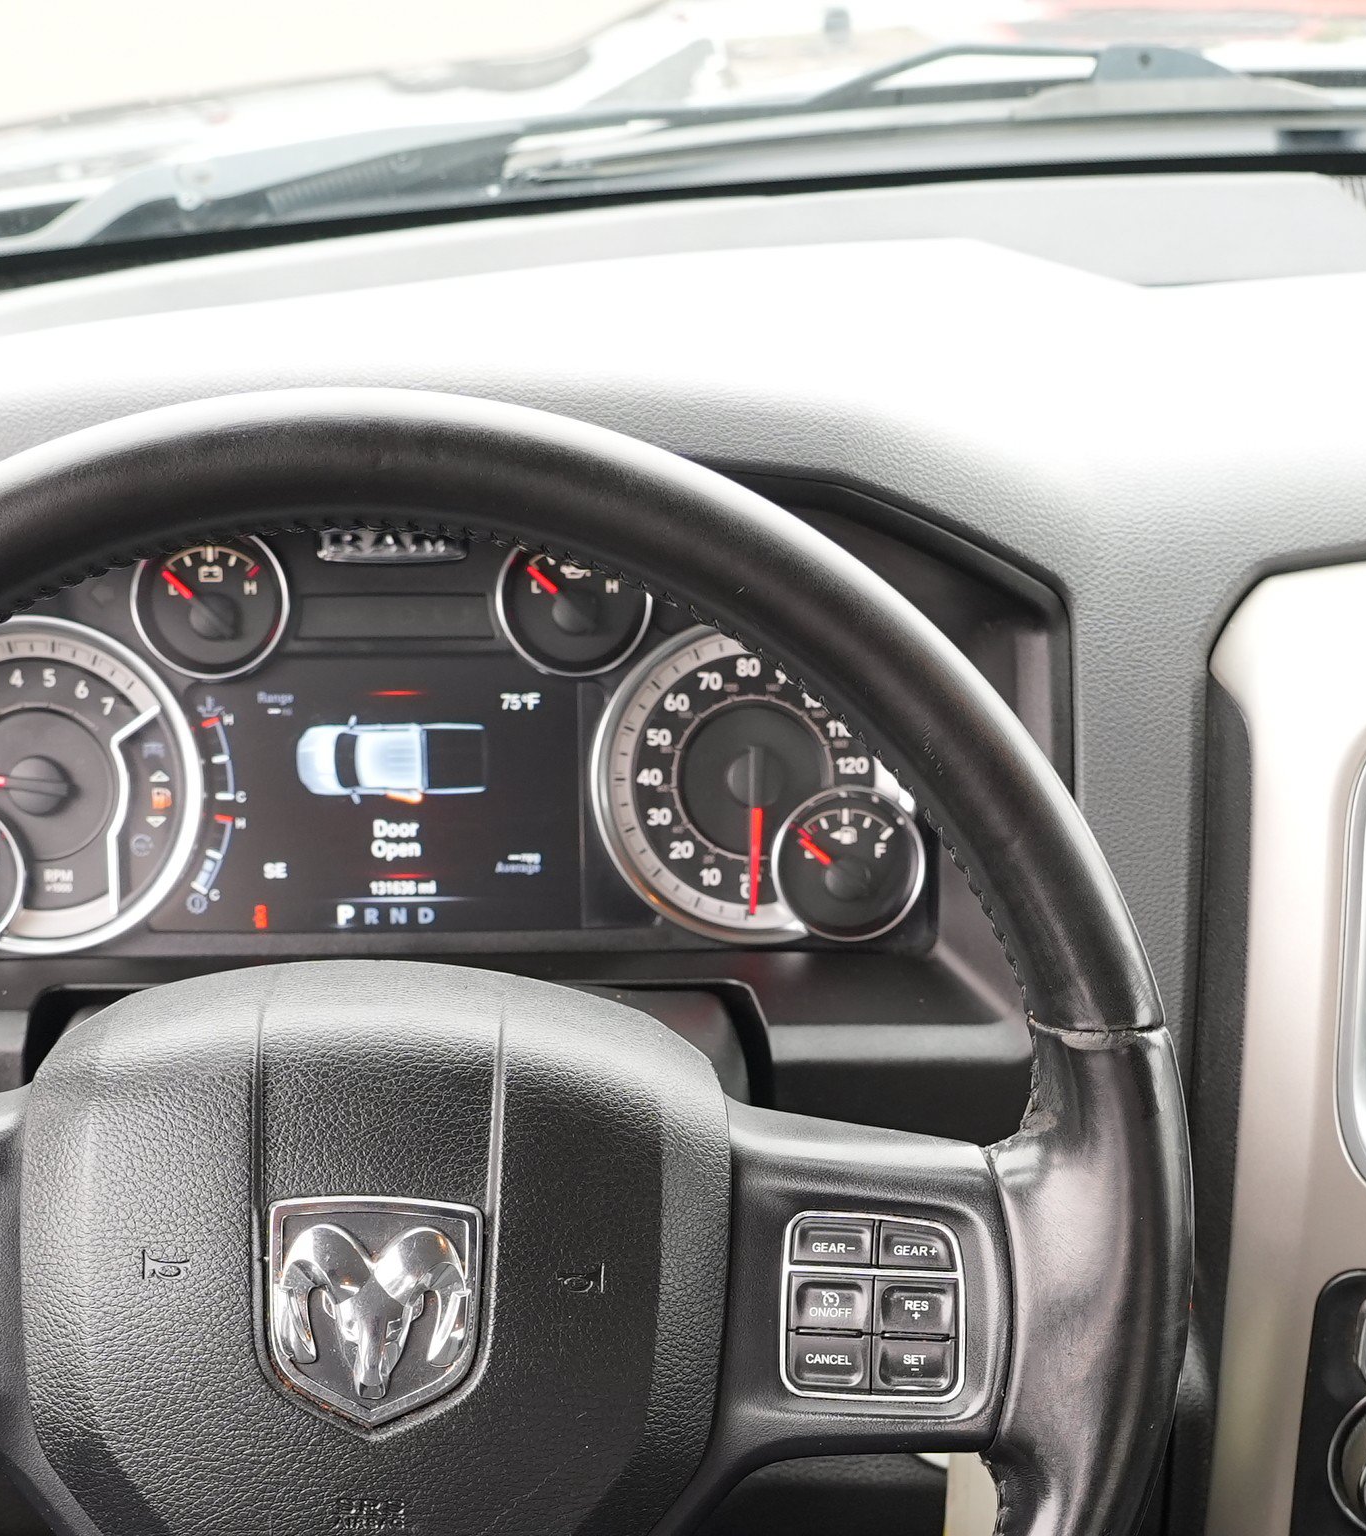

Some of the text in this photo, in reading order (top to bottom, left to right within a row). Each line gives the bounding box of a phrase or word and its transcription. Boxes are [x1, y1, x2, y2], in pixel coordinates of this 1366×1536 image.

[736, 658, 761, 677] 80
[9, 668, 24, 688] 4
[43, 668, 57, 688] 5
[696, 671, 723, 691] 70
[75, 680, 89, 699] 6
[100, 697, 116, 716] 7
[663, 693, 690, 712] 60
[646, 728, 672, 747] 50
[836, 756, 869, 774] 120
[637, 768, 663, 786] 40
[646, 807, 672, 826] 30
[373, 819, 419, 838] Door
[371, 839, 421, 861] Open
[668, 840, 695, 860] 20
[874, 842, 886, 858] F
[43, 868, 74, 882] RPM
[263, 862, 288, 879] SE
[699, 868, 722, 886] 10
[337, 904, 435, 925] P R N D
[809, 1307, 852, 1318] ON/OFF
[904, 1300, 929, 1311] RES
[805, 1354, 852, 1365] CANCEL
[903, 1355, 926, 1365] SET
